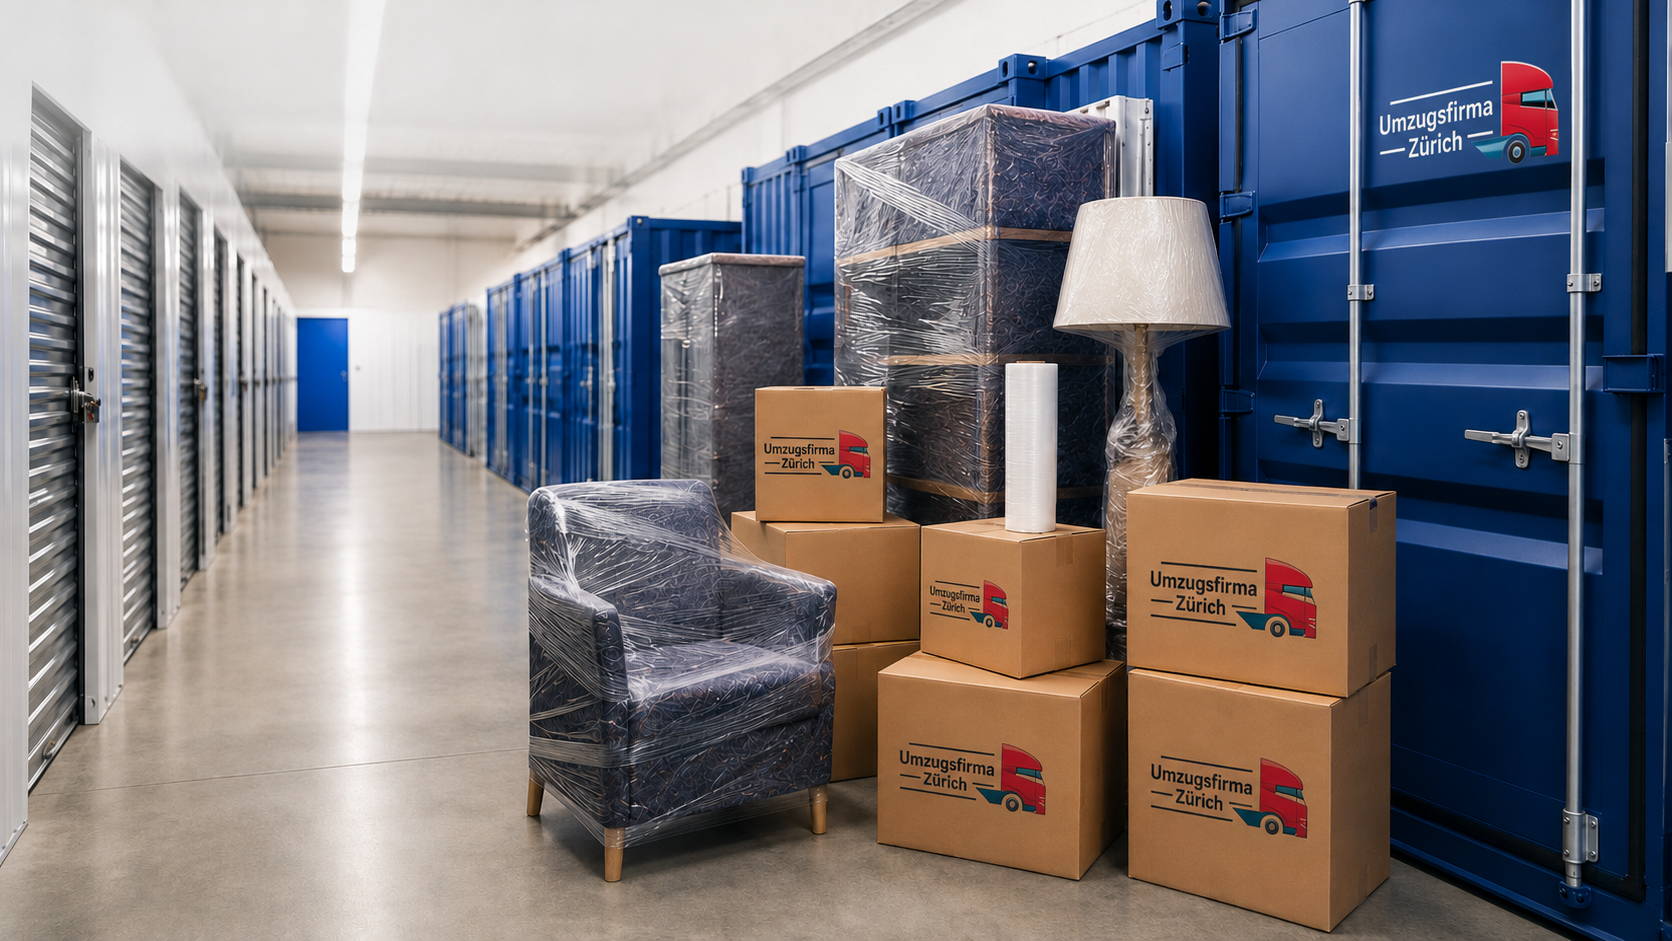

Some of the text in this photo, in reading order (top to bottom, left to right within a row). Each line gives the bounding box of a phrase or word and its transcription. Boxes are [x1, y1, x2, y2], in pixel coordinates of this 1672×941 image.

[1379, 100, 1493, 136] Umzugsfirma
[1408, 132, 1462, 158] Zürich
[764, 443, 835, 457] Umzugsfirma
[781, 457, 815, 469] Zürich
[929, 585, 980, 603] Umzugsfirma
[1150, 570, 1258, 599] Umzugsfirma
[1175, 594, 1227, 617] Zürich
[899, 749, 995, 777] Umzugsfirma
[922, 771, 967, 792] Zürich
[1150, 763, 1253, 796] Umzugsfirma
[1175, 788, 1223, 811] Zürich
